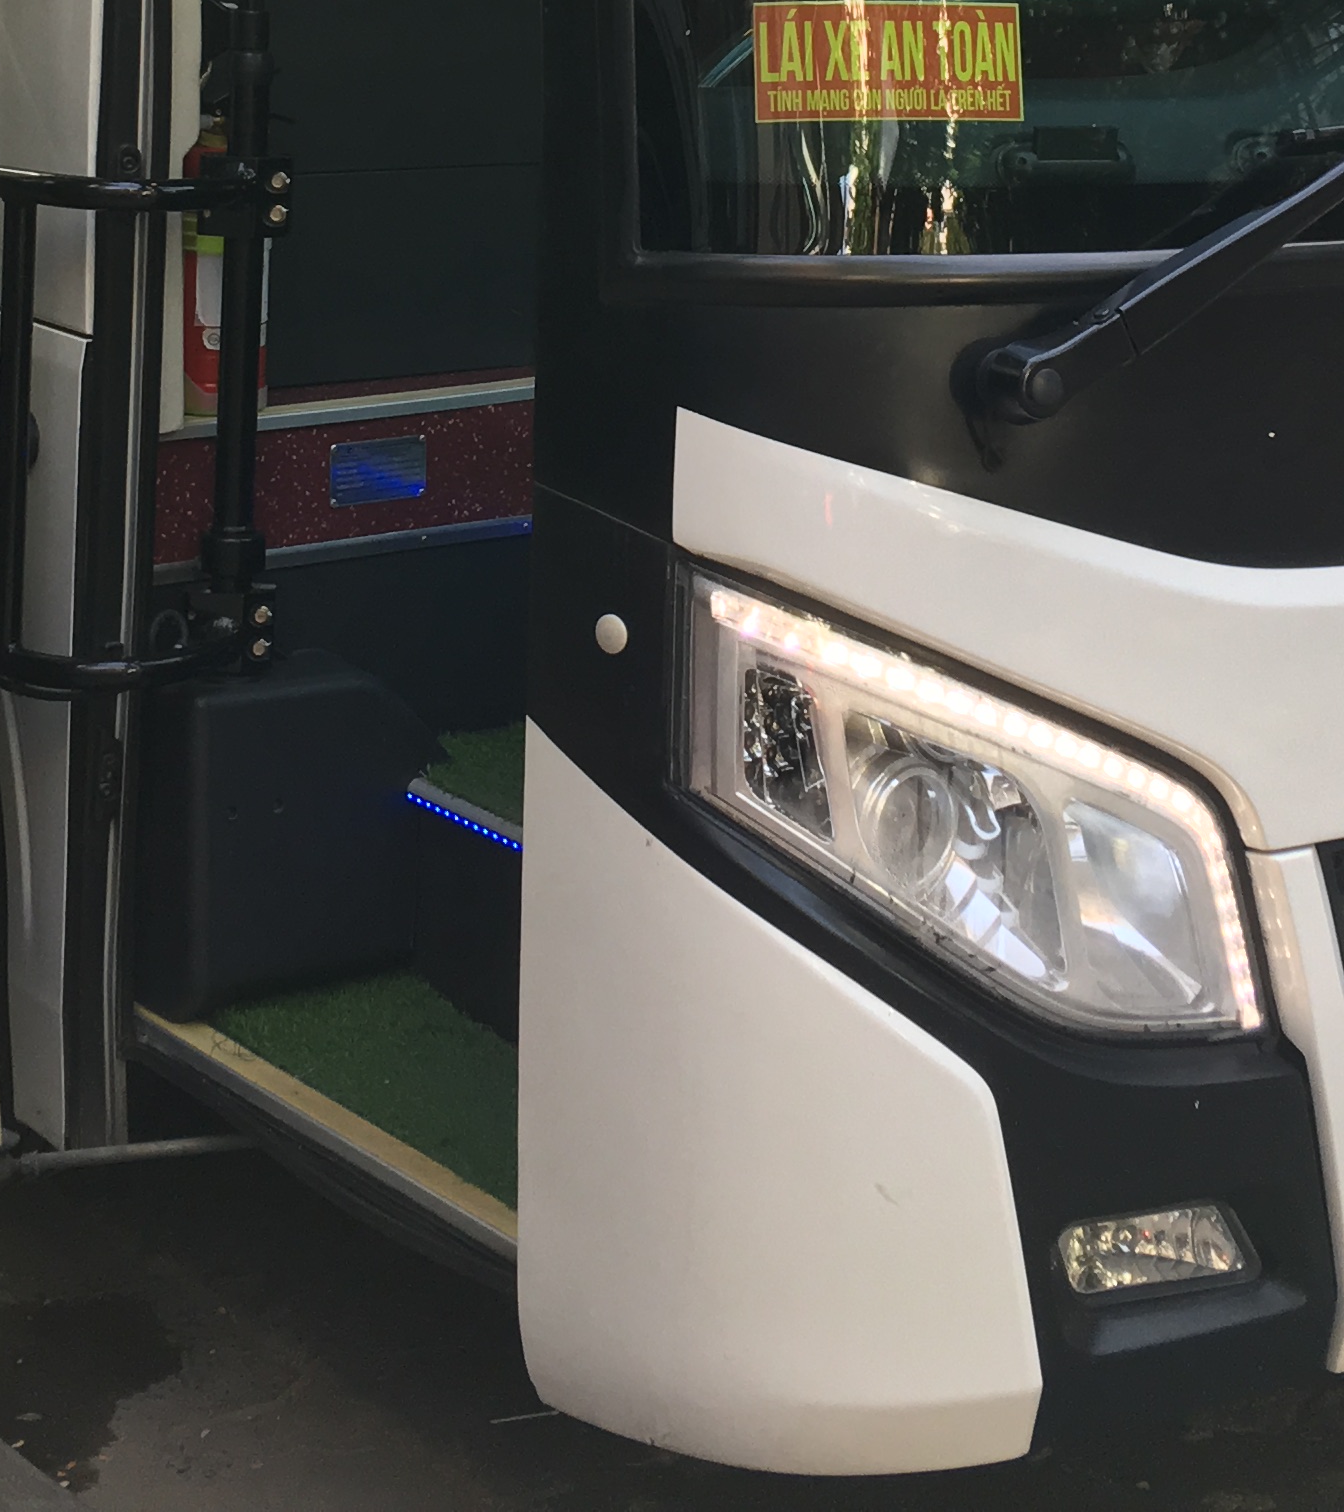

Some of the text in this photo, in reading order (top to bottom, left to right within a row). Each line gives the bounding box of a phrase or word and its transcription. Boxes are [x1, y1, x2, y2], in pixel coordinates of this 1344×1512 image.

[759, 9, 1016, 83] LÁI XE AN TOÀN
[768, 86, 803, 112] TÍNH
[988, 83, 1011, 111] HẾT
